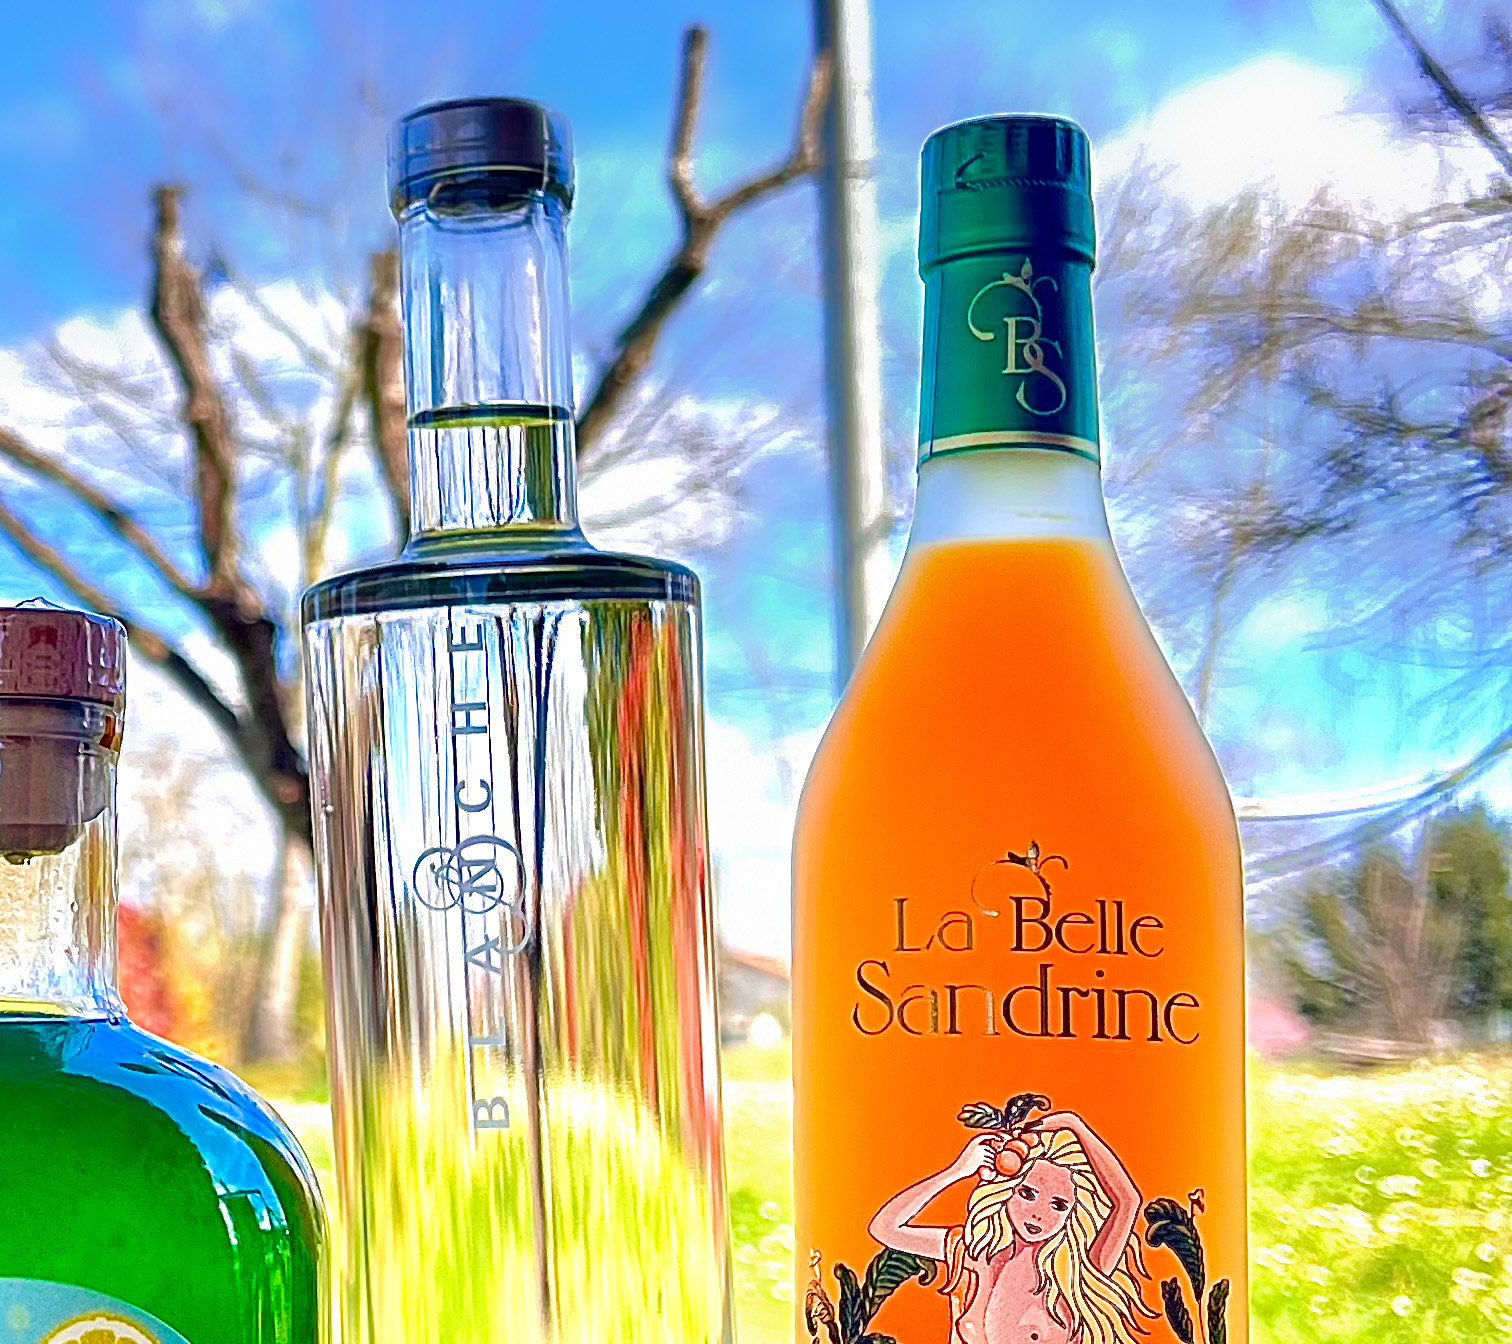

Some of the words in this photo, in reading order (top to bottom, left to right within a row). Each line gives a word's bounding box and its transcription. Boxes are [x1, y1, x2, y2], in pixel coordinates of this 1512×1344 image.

[893, 896, 973, 953] La
[1009, 895, 1164, 958] Belle
[852, 959, 1200, 1046] Sandrine
